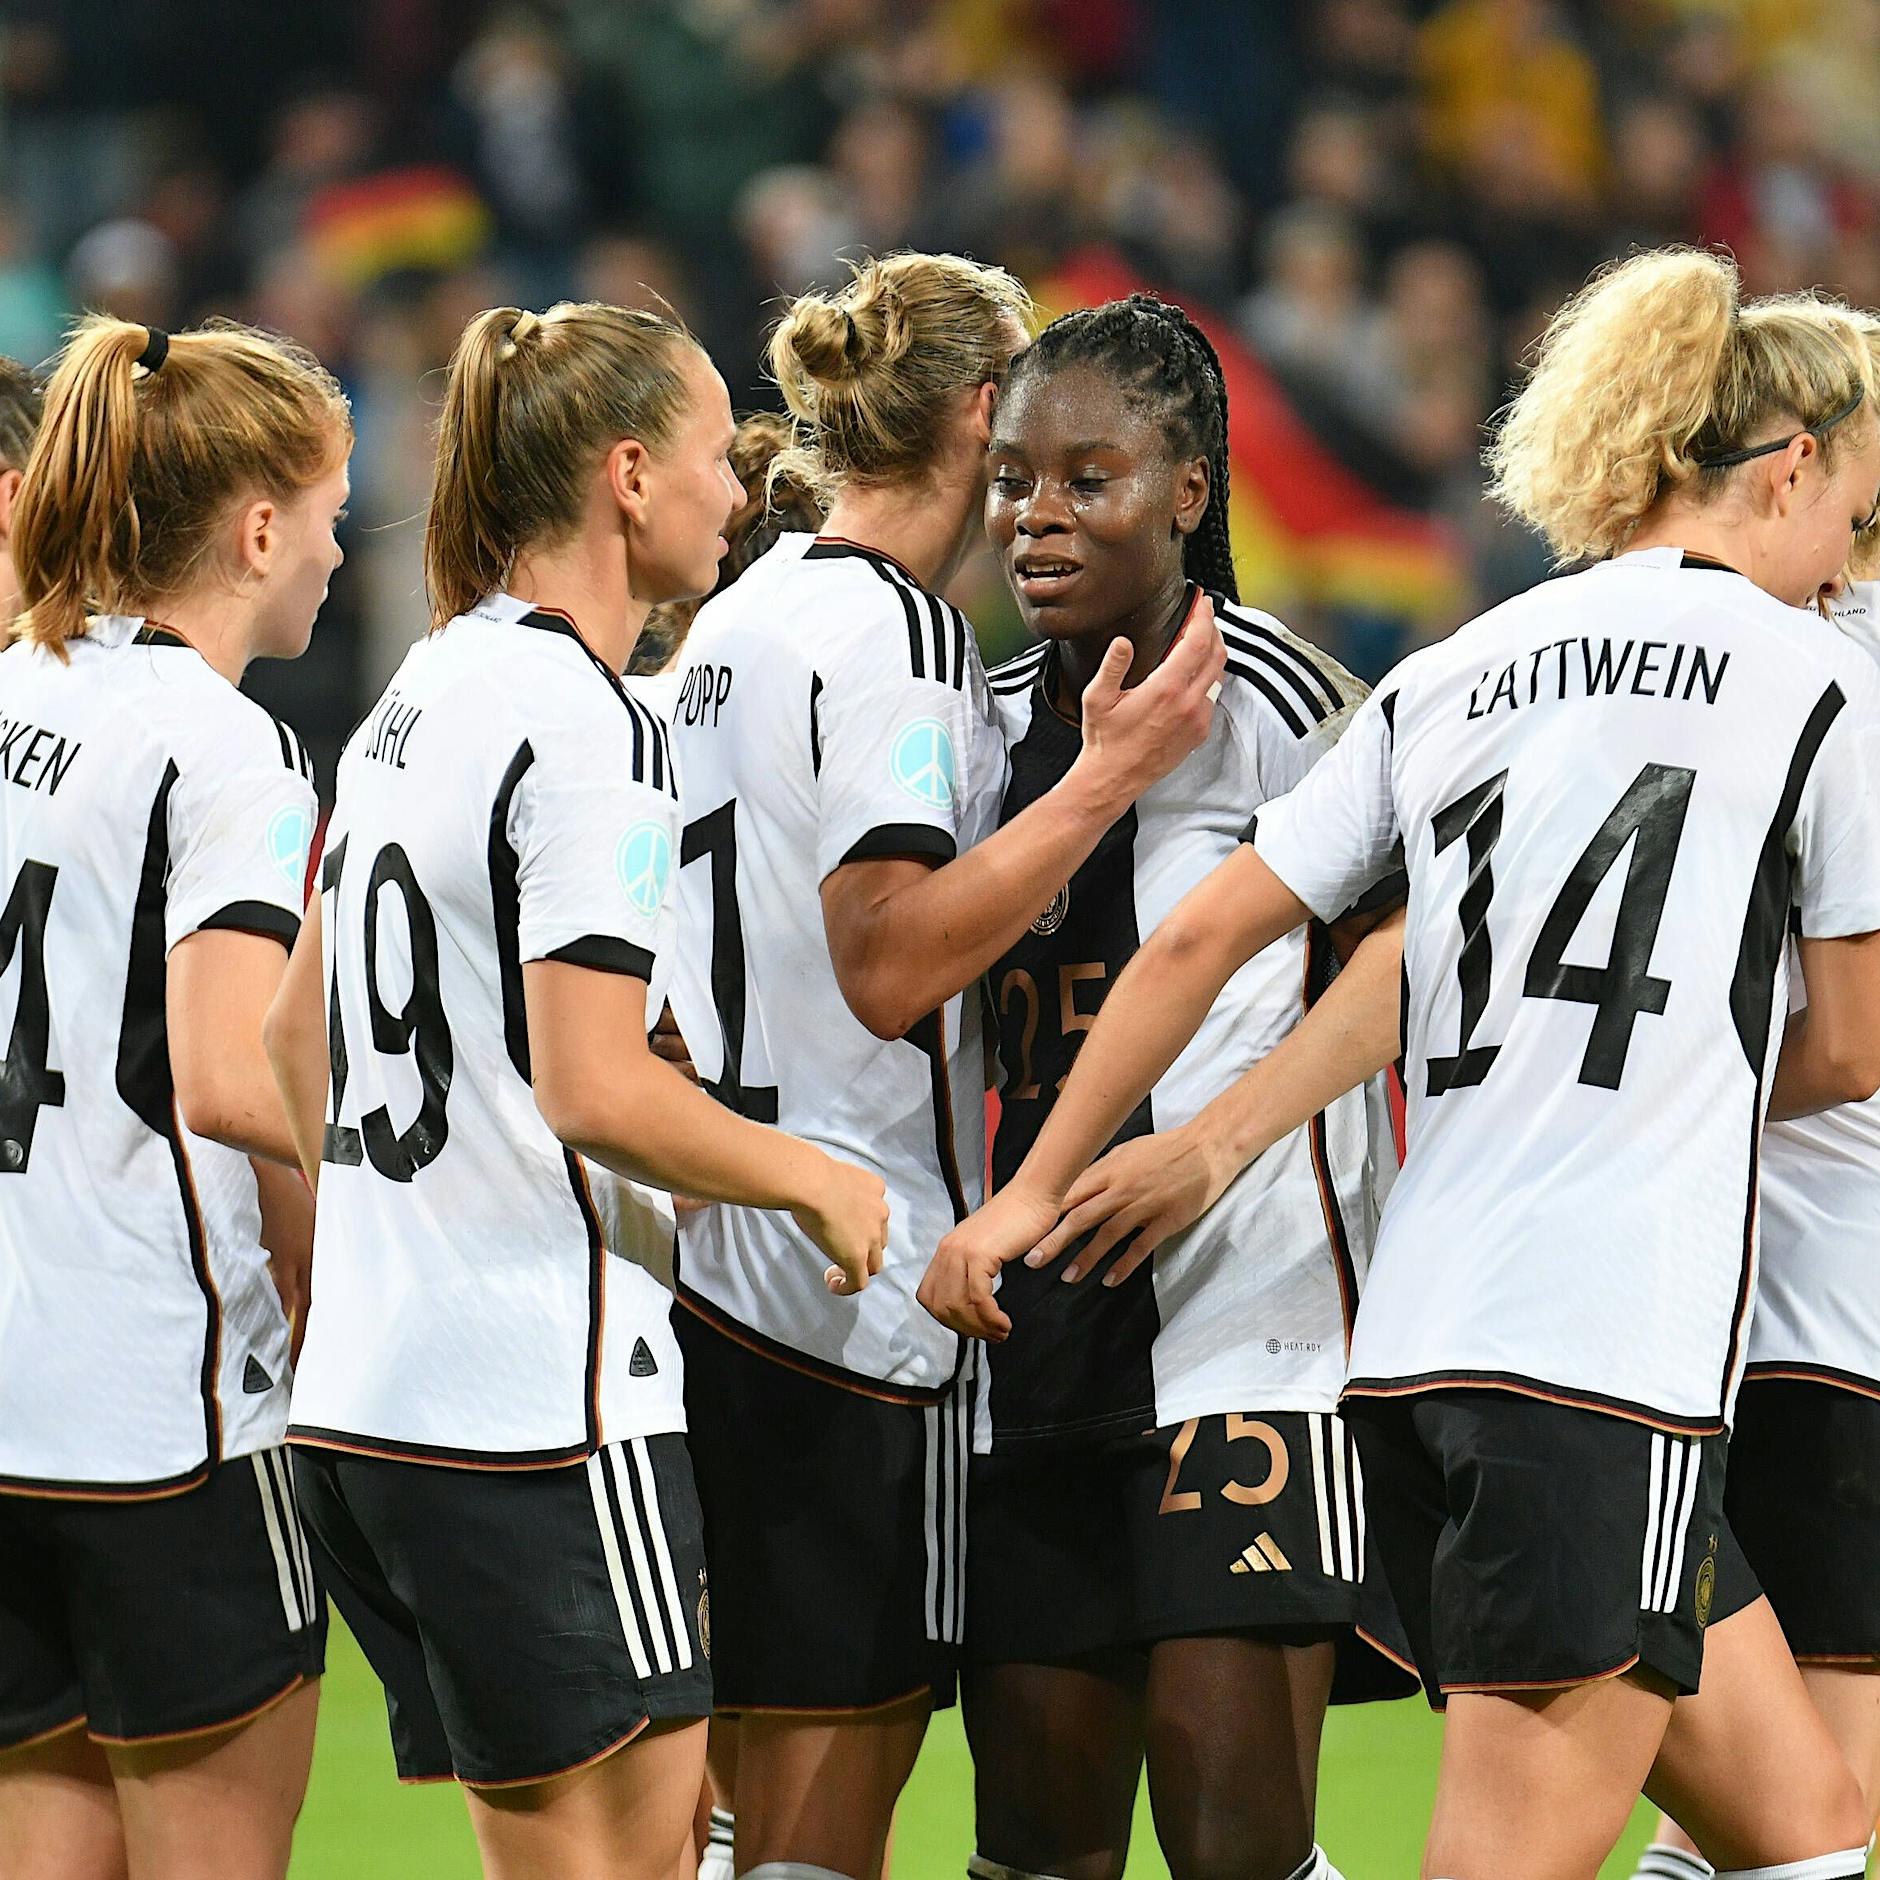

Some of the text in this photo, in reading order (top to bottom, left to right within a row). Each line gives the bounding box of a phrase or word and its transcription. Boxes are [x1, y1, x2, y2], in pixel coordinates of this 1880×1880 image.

[672, 663, 733, 728] POPP
[1466, 635, 1731, 721] LATTWEIN
[0, 717, 82, 796] KEN
[365, 689, 422, 770] ÜHL
[1425, 761, 1698, 1098] 14
[322, 831, 455, 1184] 19
[1283, 1341, 1322, 1353] HEAT RDY
[1141, 1412, 1290, 1515] 25
